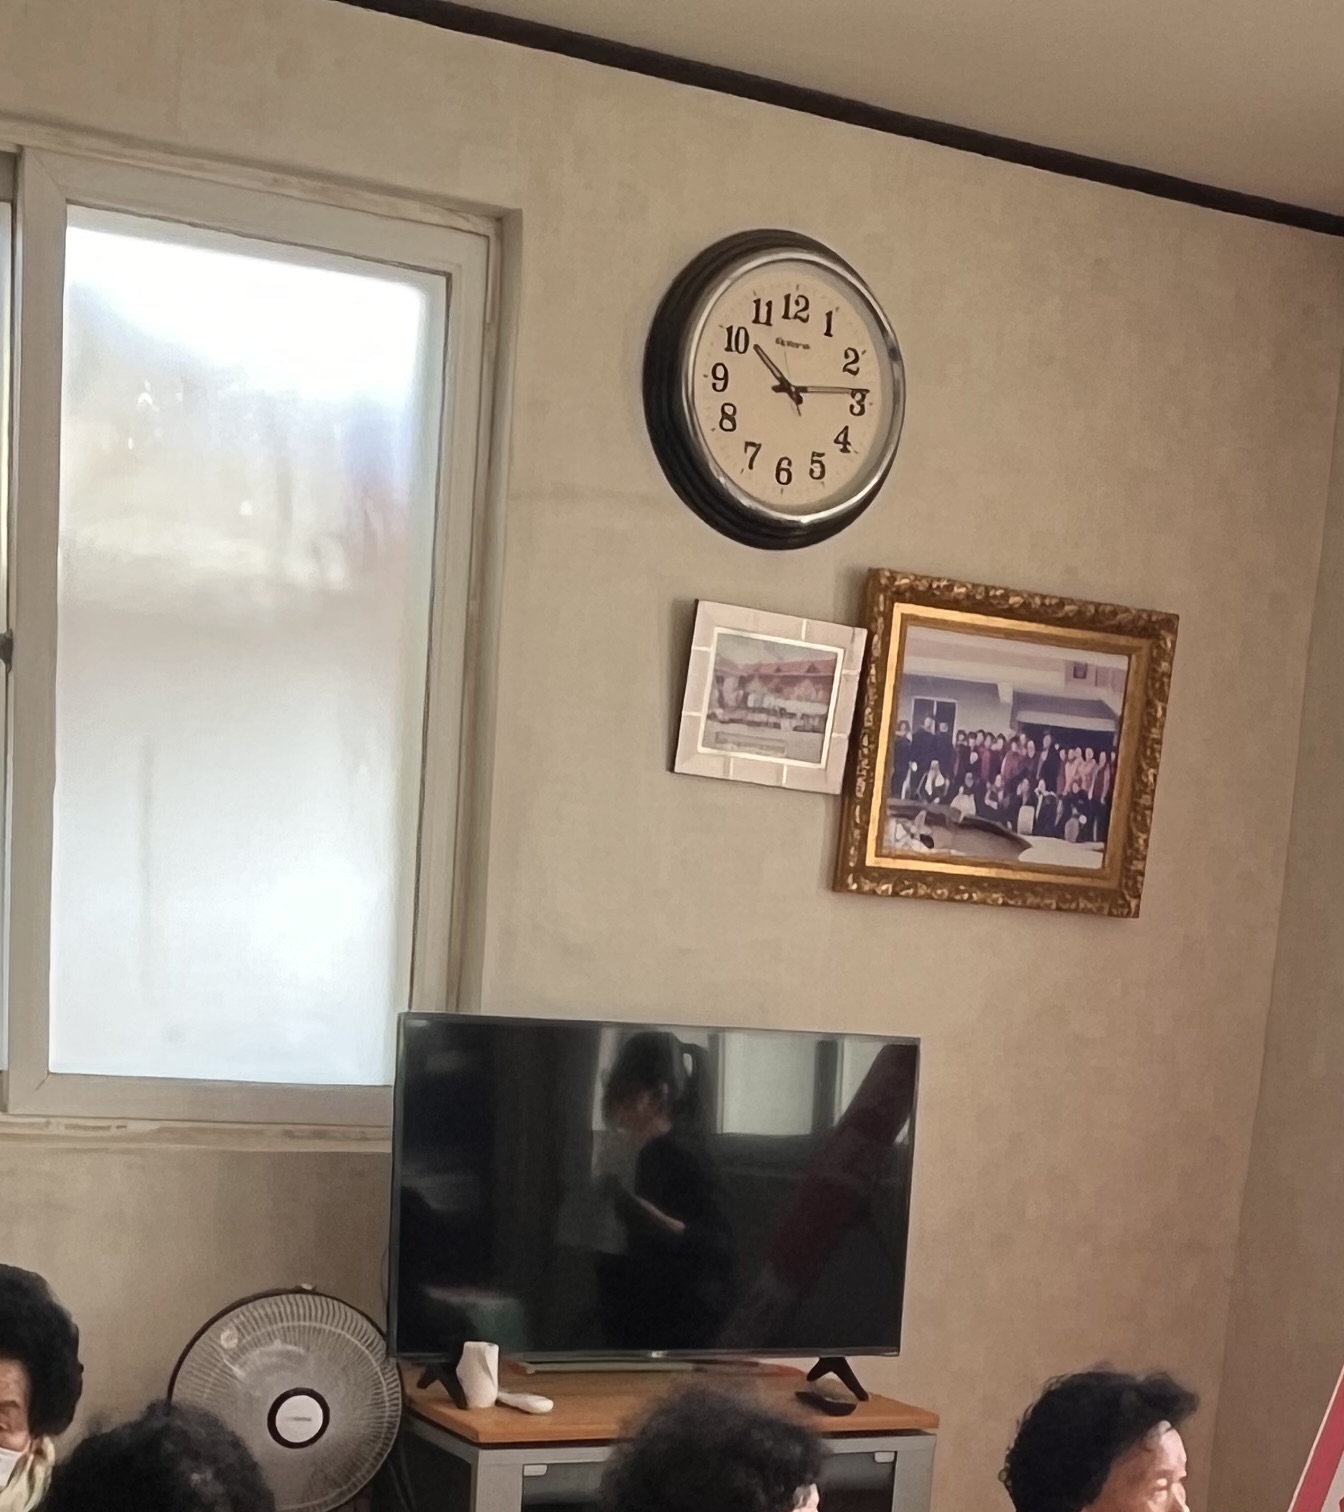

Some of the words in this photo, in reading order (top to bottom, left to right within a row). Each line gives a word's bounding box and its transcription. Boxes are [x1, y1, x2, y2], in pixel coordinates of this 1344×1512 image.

[752, 298, 773, 327] 11
[781, 293, 810, 323] 12
[824, 310, 833, 337] 1
[724, 325, 750, 354] 10
[842, 347, 860, 376] 2
[711, 362, 729, 392] 9
[849, 388, 866, 416] 3
[719, 402, 737, 432] 8
[833, 425, 852, 453] 4
[744, 441, 762, 470] 7
[809, 451, 826, 480] 5
[775, 456, 793, 485] 6
